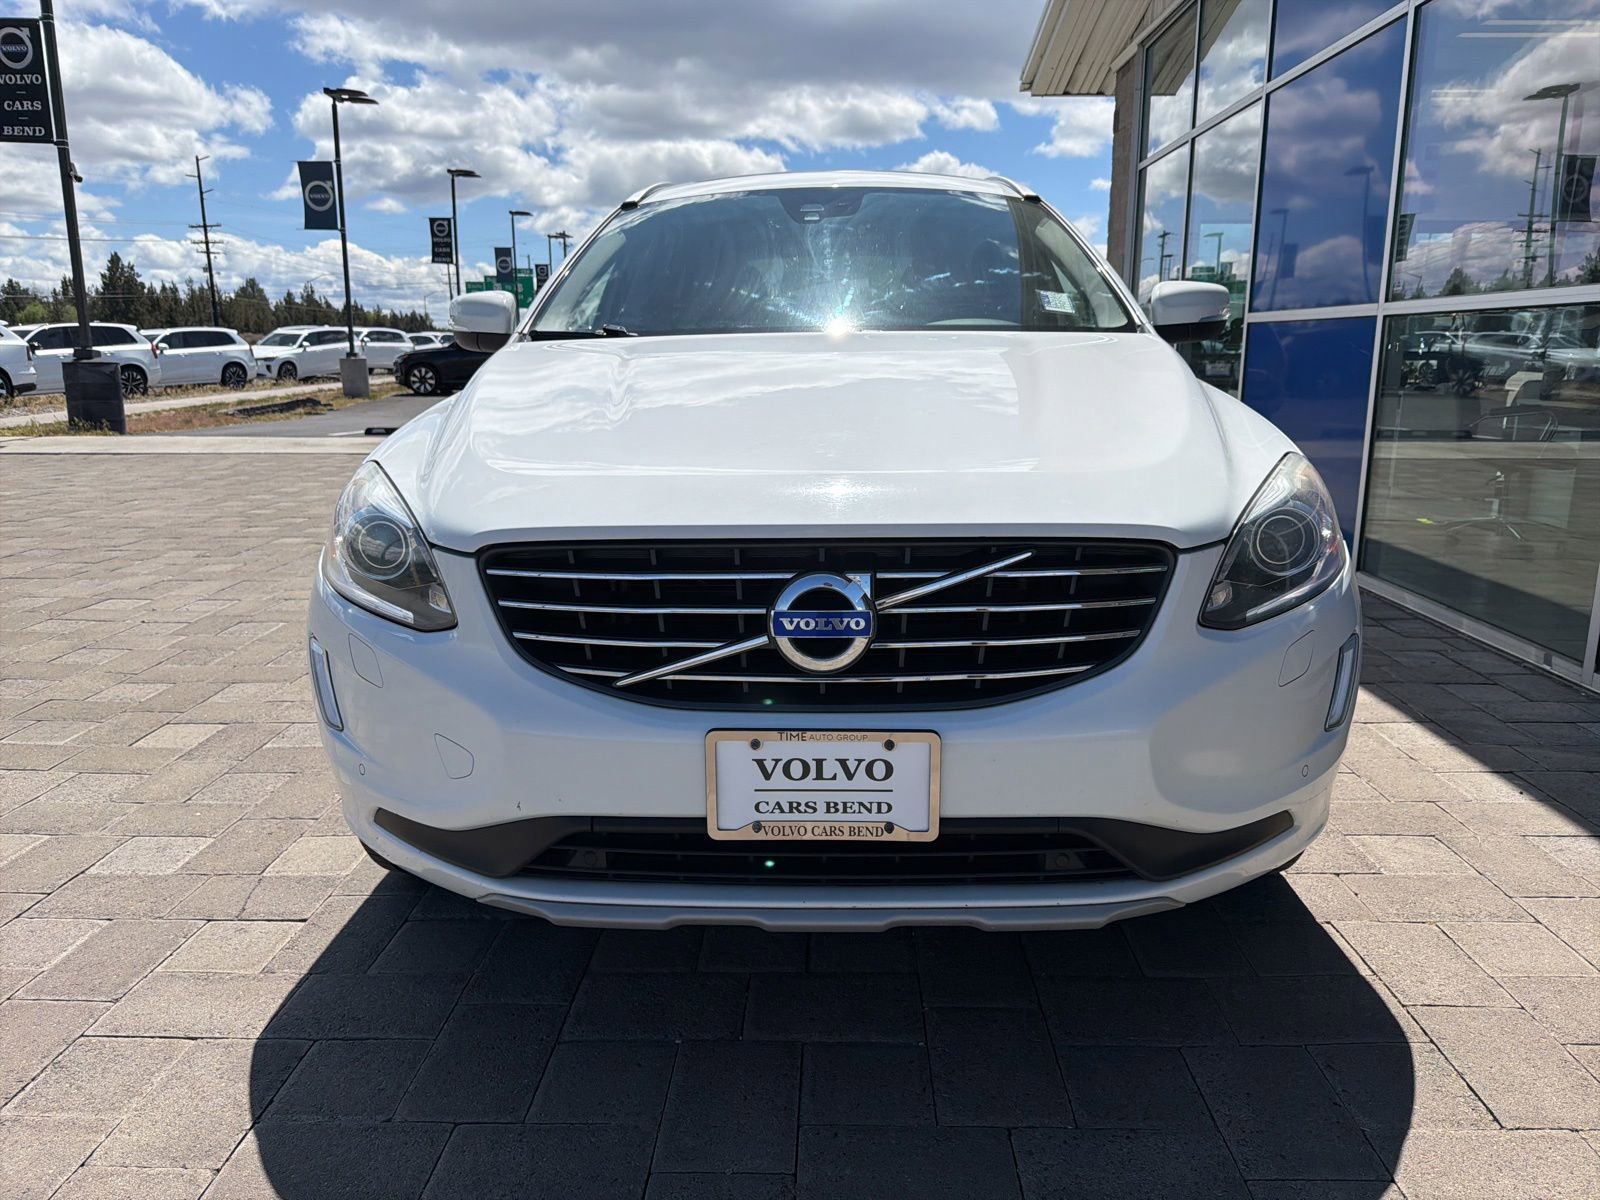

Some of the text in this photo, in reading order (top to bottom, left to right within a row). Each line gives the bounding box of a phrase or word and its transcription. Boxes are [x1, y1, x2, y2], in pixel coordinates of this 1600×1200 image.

[3, 101, 42, 111] CARS
[2, 126, 45, 137] BEND
[779, 617, 866, 631] VOLVO
[777, 731, 869, 742] TIME AUTO GROUP
[752, 758, 894, 782] VOLVO
[754, 800, 893, 815] CARS BEND
[761, 825, 884, 838] VOLVO CARS BEND
